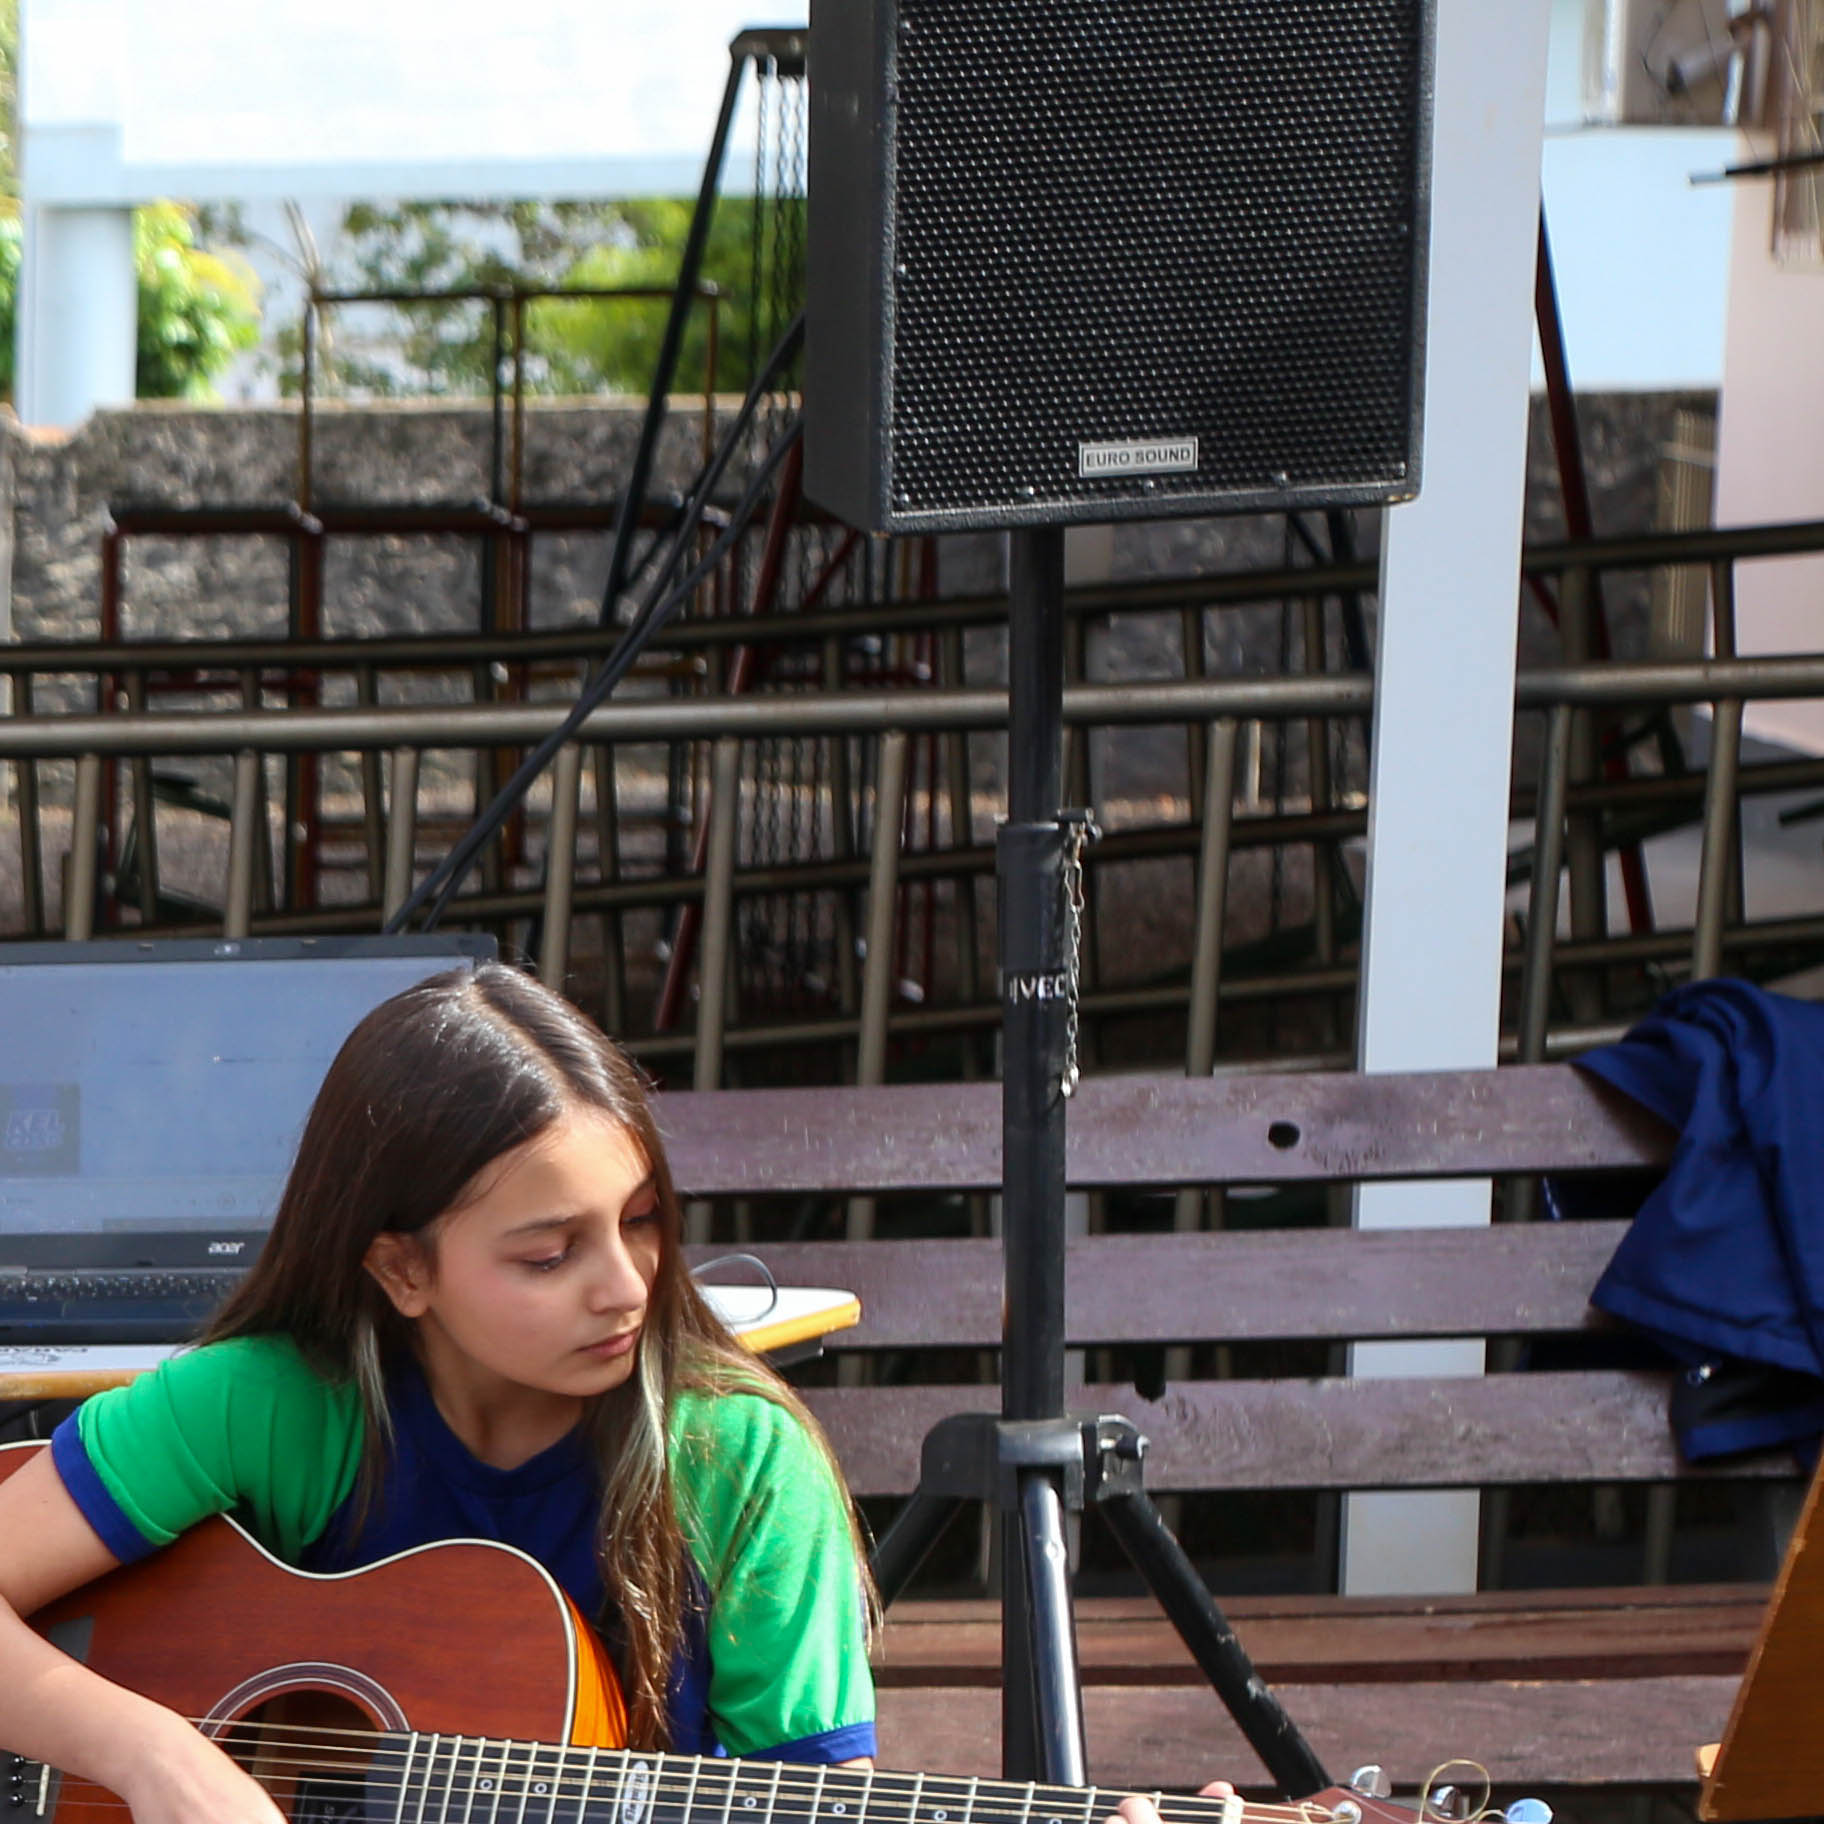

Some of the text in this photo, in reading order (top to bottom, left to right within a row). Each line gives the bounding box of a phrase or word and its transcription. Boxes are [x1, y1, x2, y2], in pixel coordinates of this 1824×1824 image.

[1085, 446, 1191, 468] EURO SOUND
[207, 1241, 246, 1255] acer
